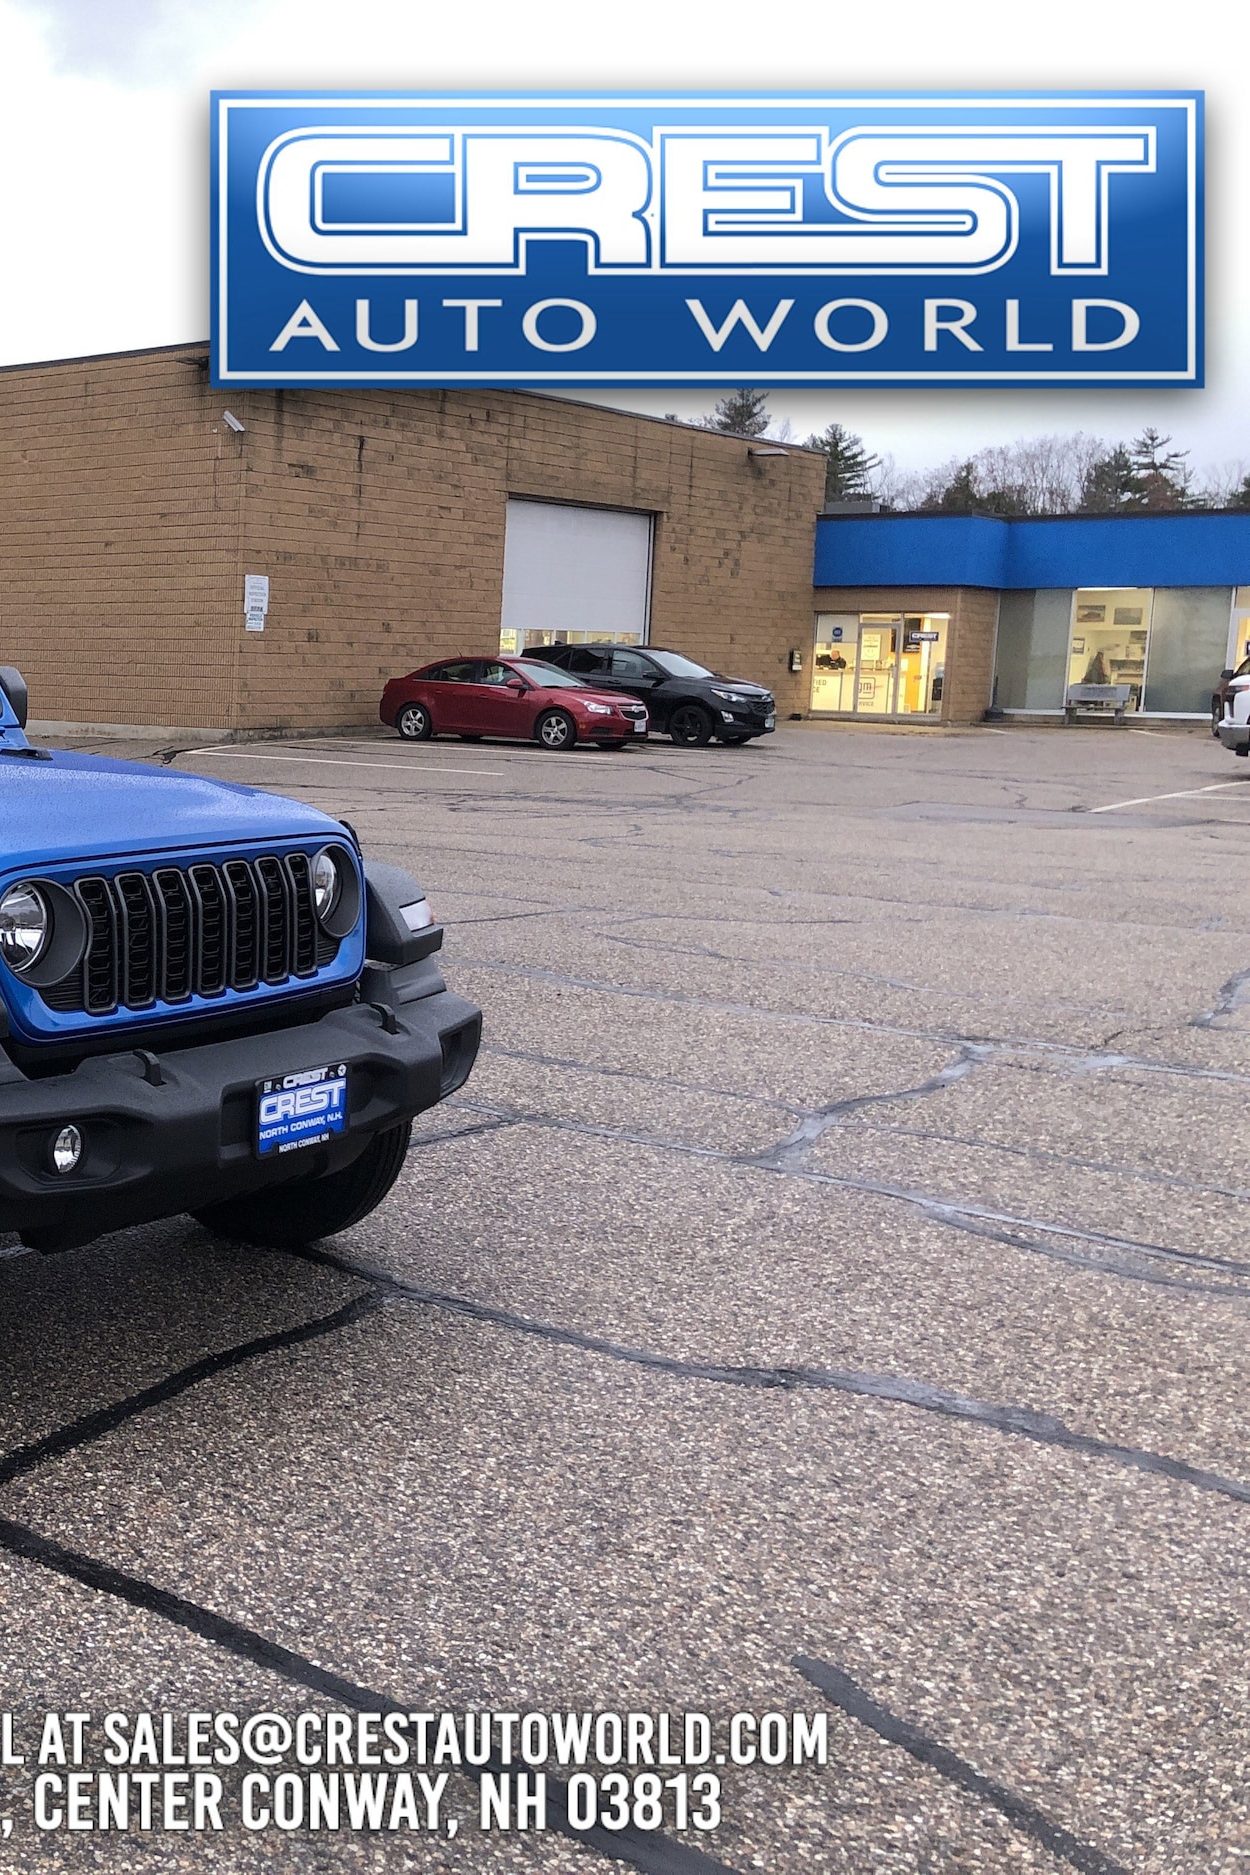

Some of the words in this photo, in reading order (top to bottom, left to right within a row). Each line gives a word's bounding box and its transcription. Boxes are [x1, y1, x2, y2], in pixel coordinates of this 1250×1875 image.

[283, 1067, 328, 1089] CREST
[259, 1079, 346, 1125] CREST
[259, 1125, 288, 1141] NORTH
[290, 1115, 326, 1132] CONWAY,
[327, 1111, 343, 1123] N.H.
[279, 1142, 297, 1153] NORTH
[321, 1133, 330, 1142] NH
